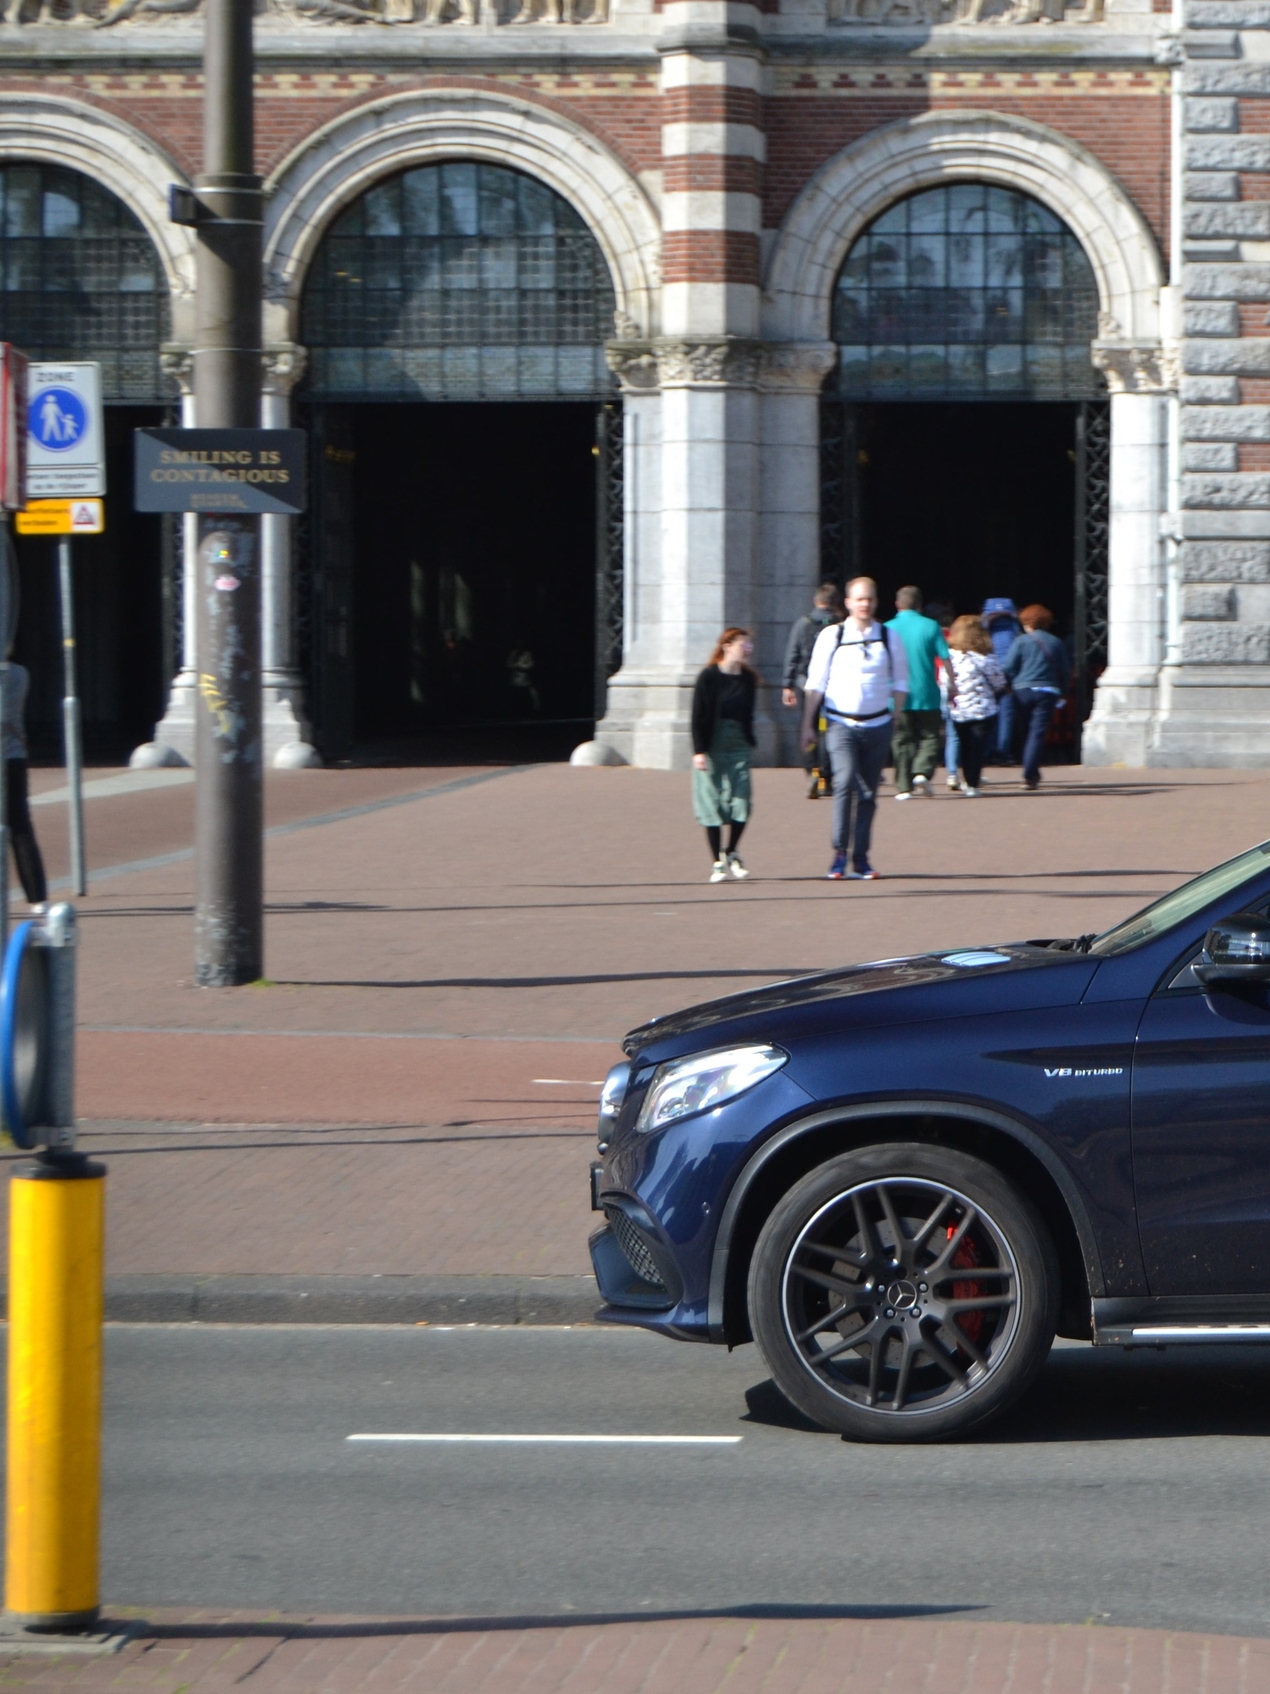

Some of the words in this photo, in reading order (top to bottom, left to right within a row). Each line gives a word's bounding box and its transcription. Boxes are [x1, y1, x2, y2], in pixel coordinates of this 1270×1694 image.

[36, 371, 75, 383] ZONE
[160, 450, 253, 465] SMILING
[258, 450, 281, 465] IS
[150, 469, 291, 483] CONTAGIOUS
